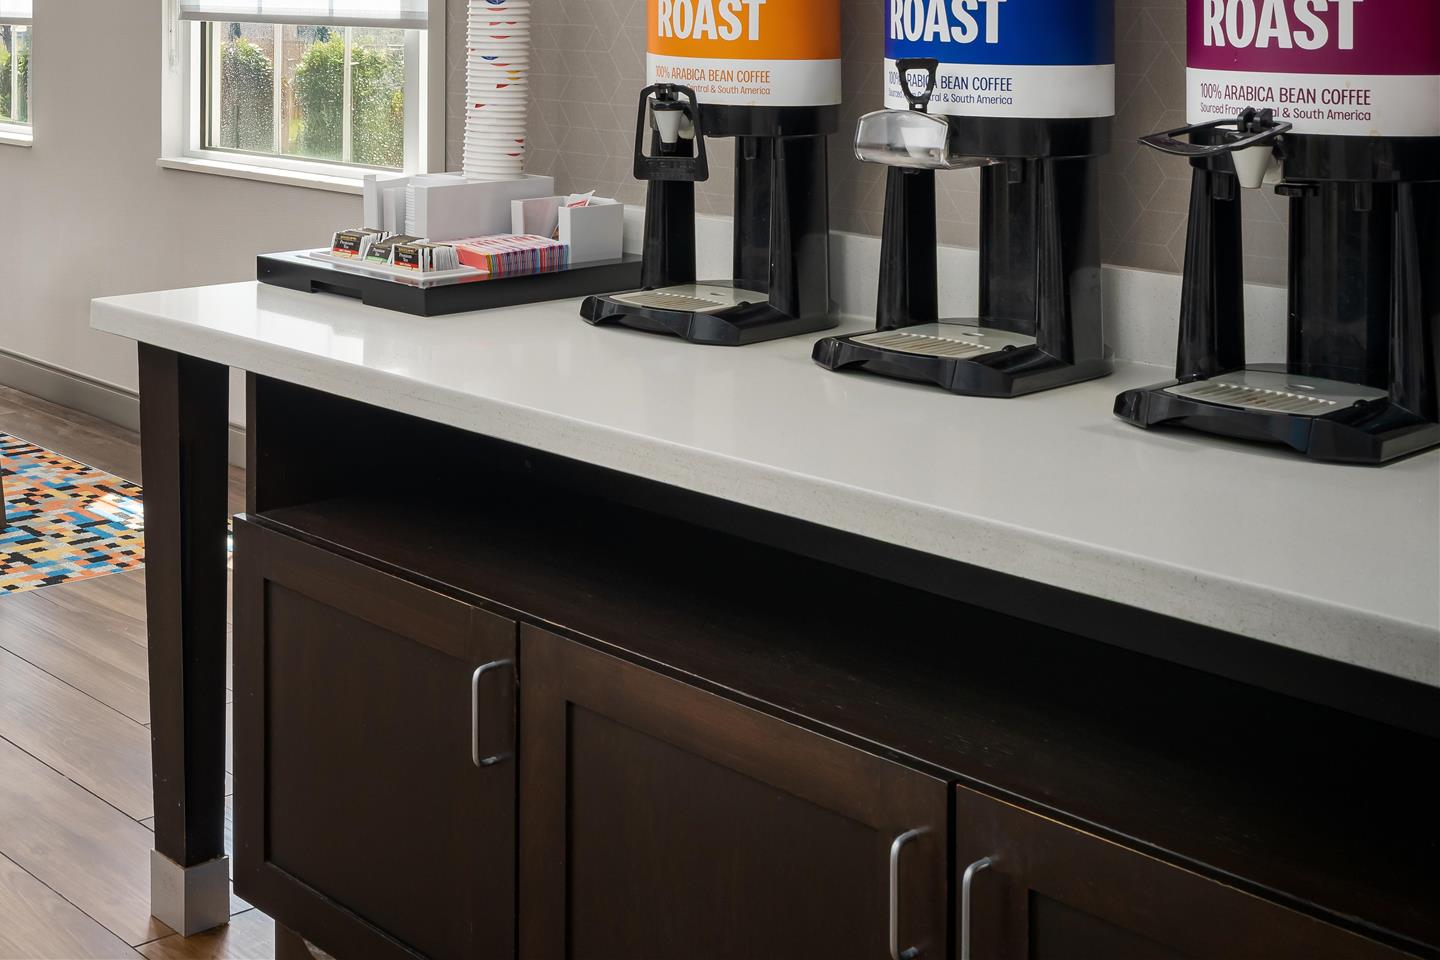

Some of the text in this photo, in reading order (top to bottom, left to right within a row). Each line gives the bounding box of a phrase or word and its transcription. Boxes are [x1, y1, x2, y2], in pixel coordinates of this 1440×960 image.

[656, 65, 770, 83] 100% ARABICA BEAN COFFEE
[710, 84, 716, 93] &
[718, 85, 738, 94] South
[740, 86, 770, 95] America
[940, 75, 968, 90] BEAN
[971, 76, 1012, 91] COFFEE
[942, 93, 950, 102] &
[951, 93, 976, 104] South
[977, 95, 1012, 105] America
[1201, 83, 1371, 105] 100% ARABICA BEAN COFFEE
[1200, 102, 1224, 114] Sourced
[1225, 104, 1244, 115] From
[1282, 108, 1290, 119] &
[1293, 108, 1323, 120] South
[1326, 109, 1371, 121] America
